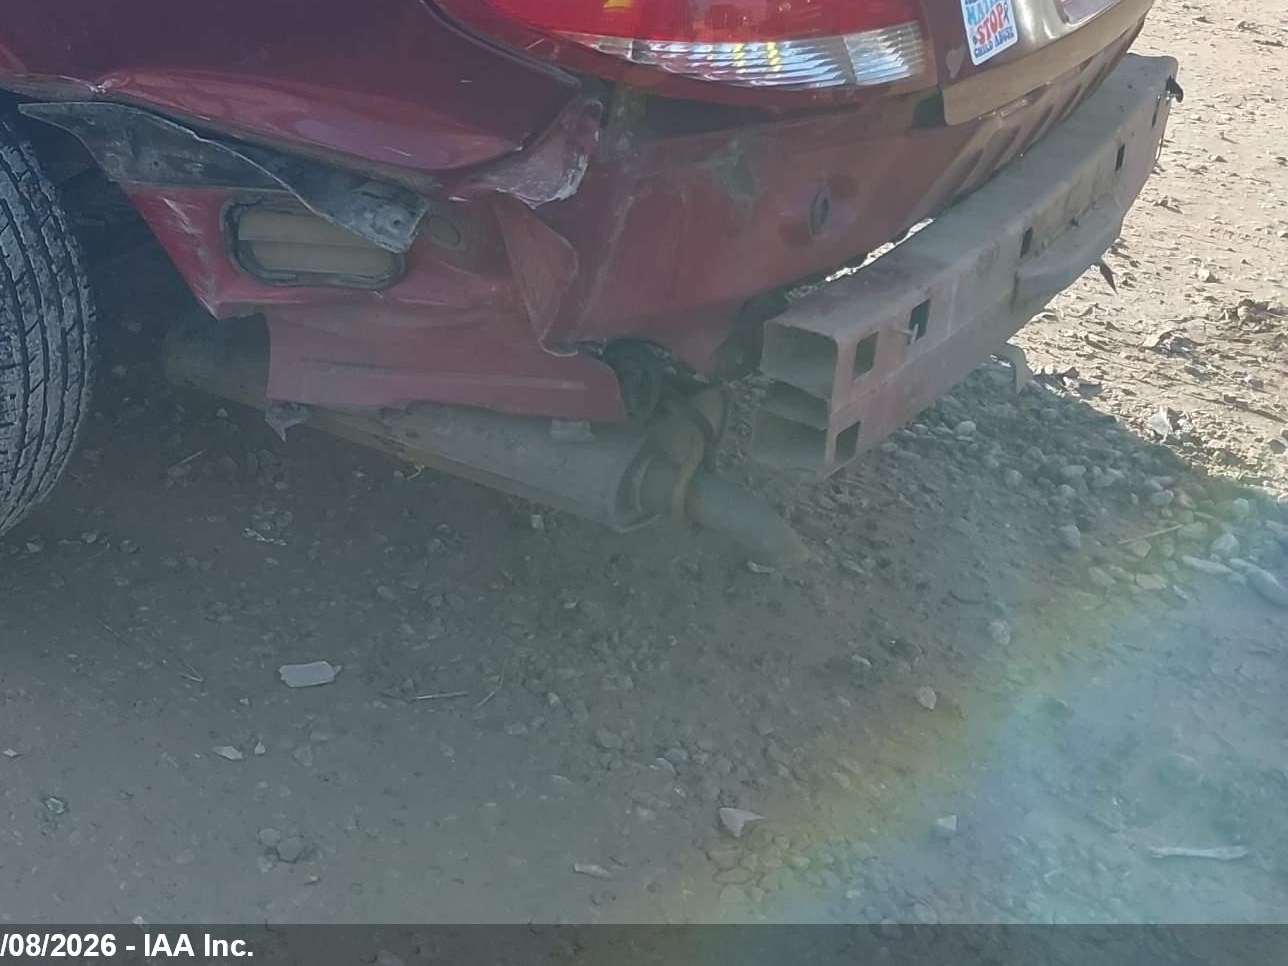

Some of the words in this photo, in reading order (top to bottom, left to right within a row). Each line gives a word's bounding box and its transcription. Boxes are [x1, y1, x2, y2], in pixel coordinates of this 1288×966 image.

[974, 41, 994, 58] CHILD
[994, 25, 1015, 48] ABUSE
[977, 2, 1004, 45] STOP
